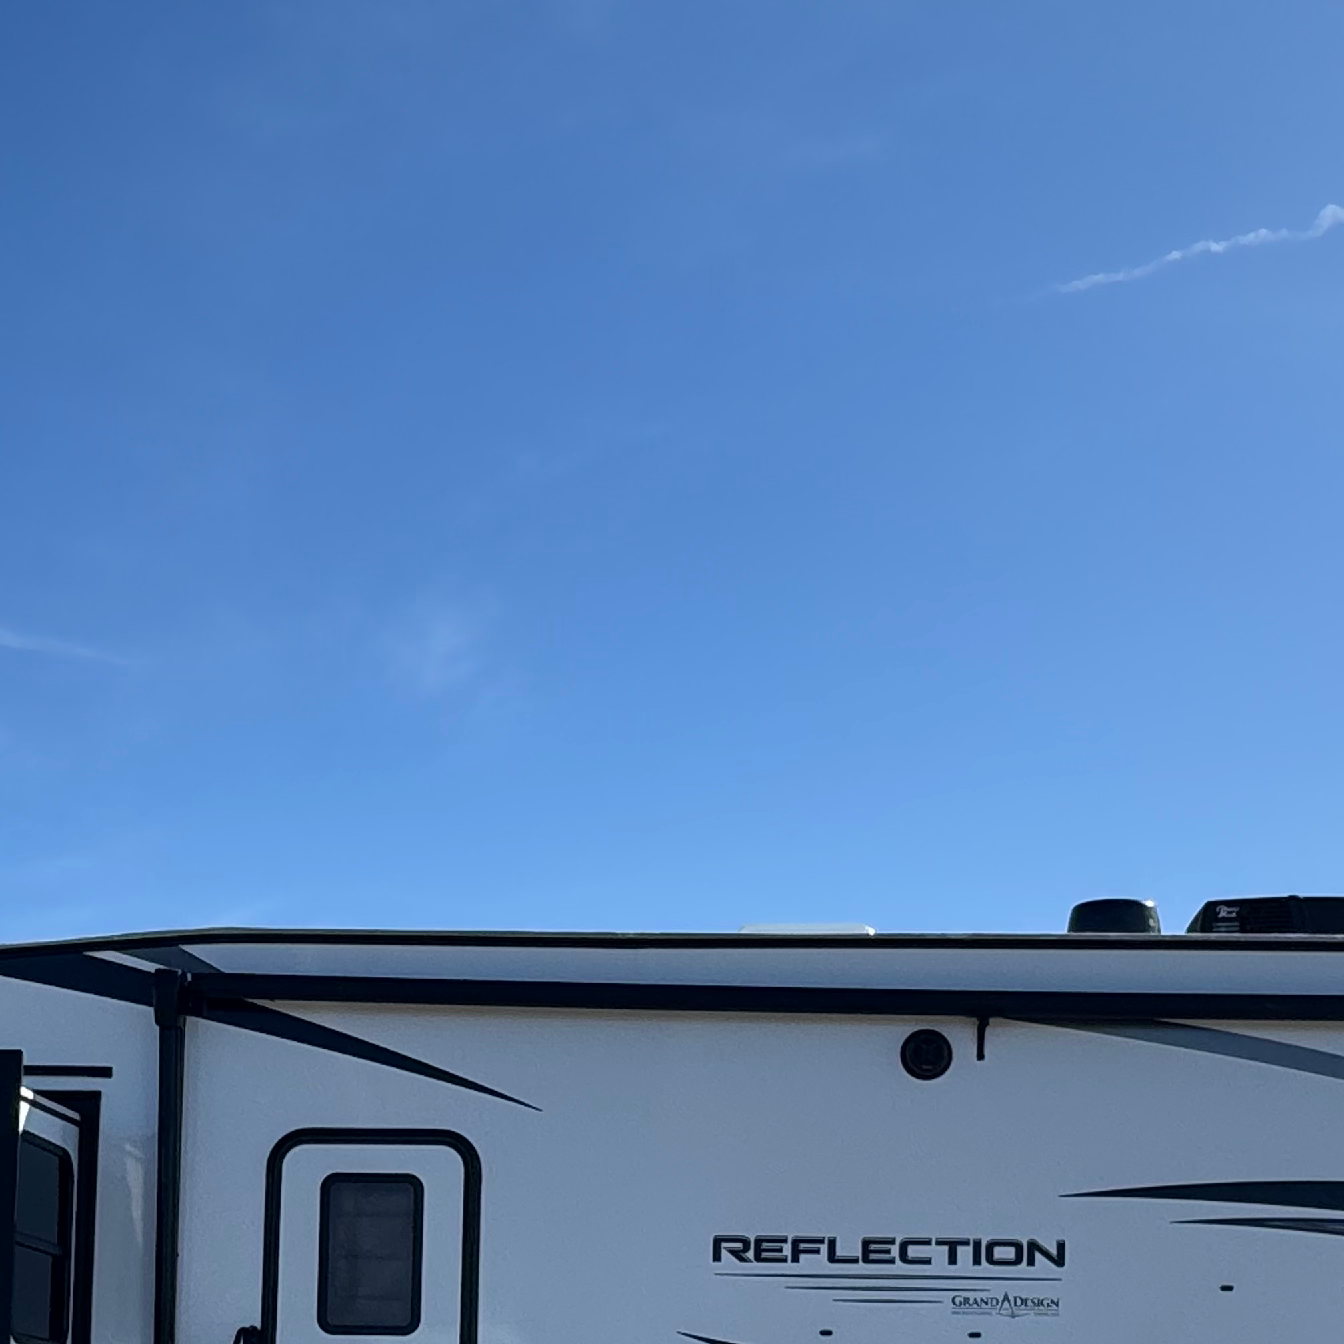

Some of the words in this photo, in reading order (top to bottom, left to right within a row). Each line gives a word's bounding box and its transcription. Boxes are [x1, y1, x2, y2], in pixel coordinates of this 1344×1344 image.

[712, 1234, 1066, 1268] REFLECTION
[951, 1295, 999, 1308] GRAND
[1013, 1296, 1060, 1308] DESIGN
